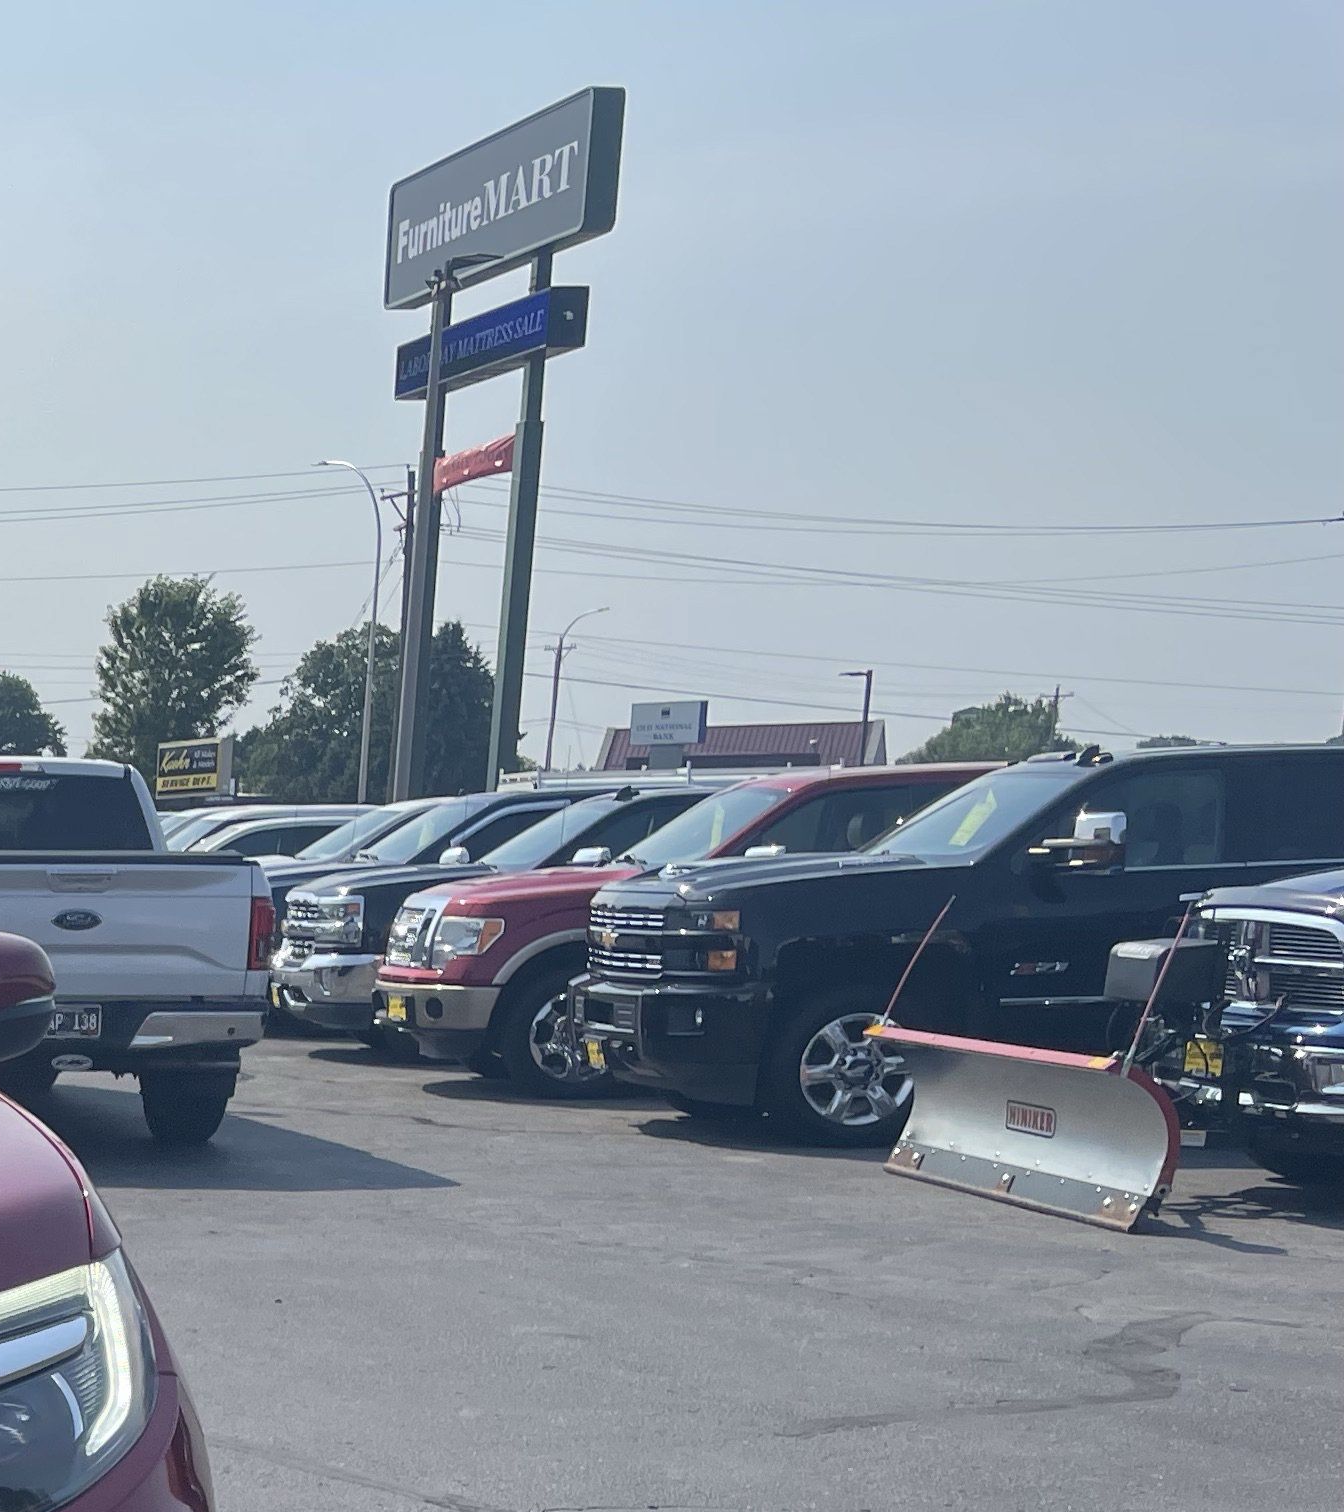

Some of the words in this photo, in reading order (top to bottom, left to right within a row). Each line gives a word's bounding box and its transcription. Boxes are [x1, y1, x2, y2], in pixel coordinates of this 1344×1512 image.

[397, 141, 578, 264] FurnitureMART
[400, 350, 430, 380] LABO
[440, 341, 457, 365] AY
[457, 322, 512, 360] MATTRESS
[514, 309, 545, 339] SALE
[162, 776, 190, 788] SERVICE
[49, 1013, 64, 1030] AP
[73, 1013, 97, 1031] 138
